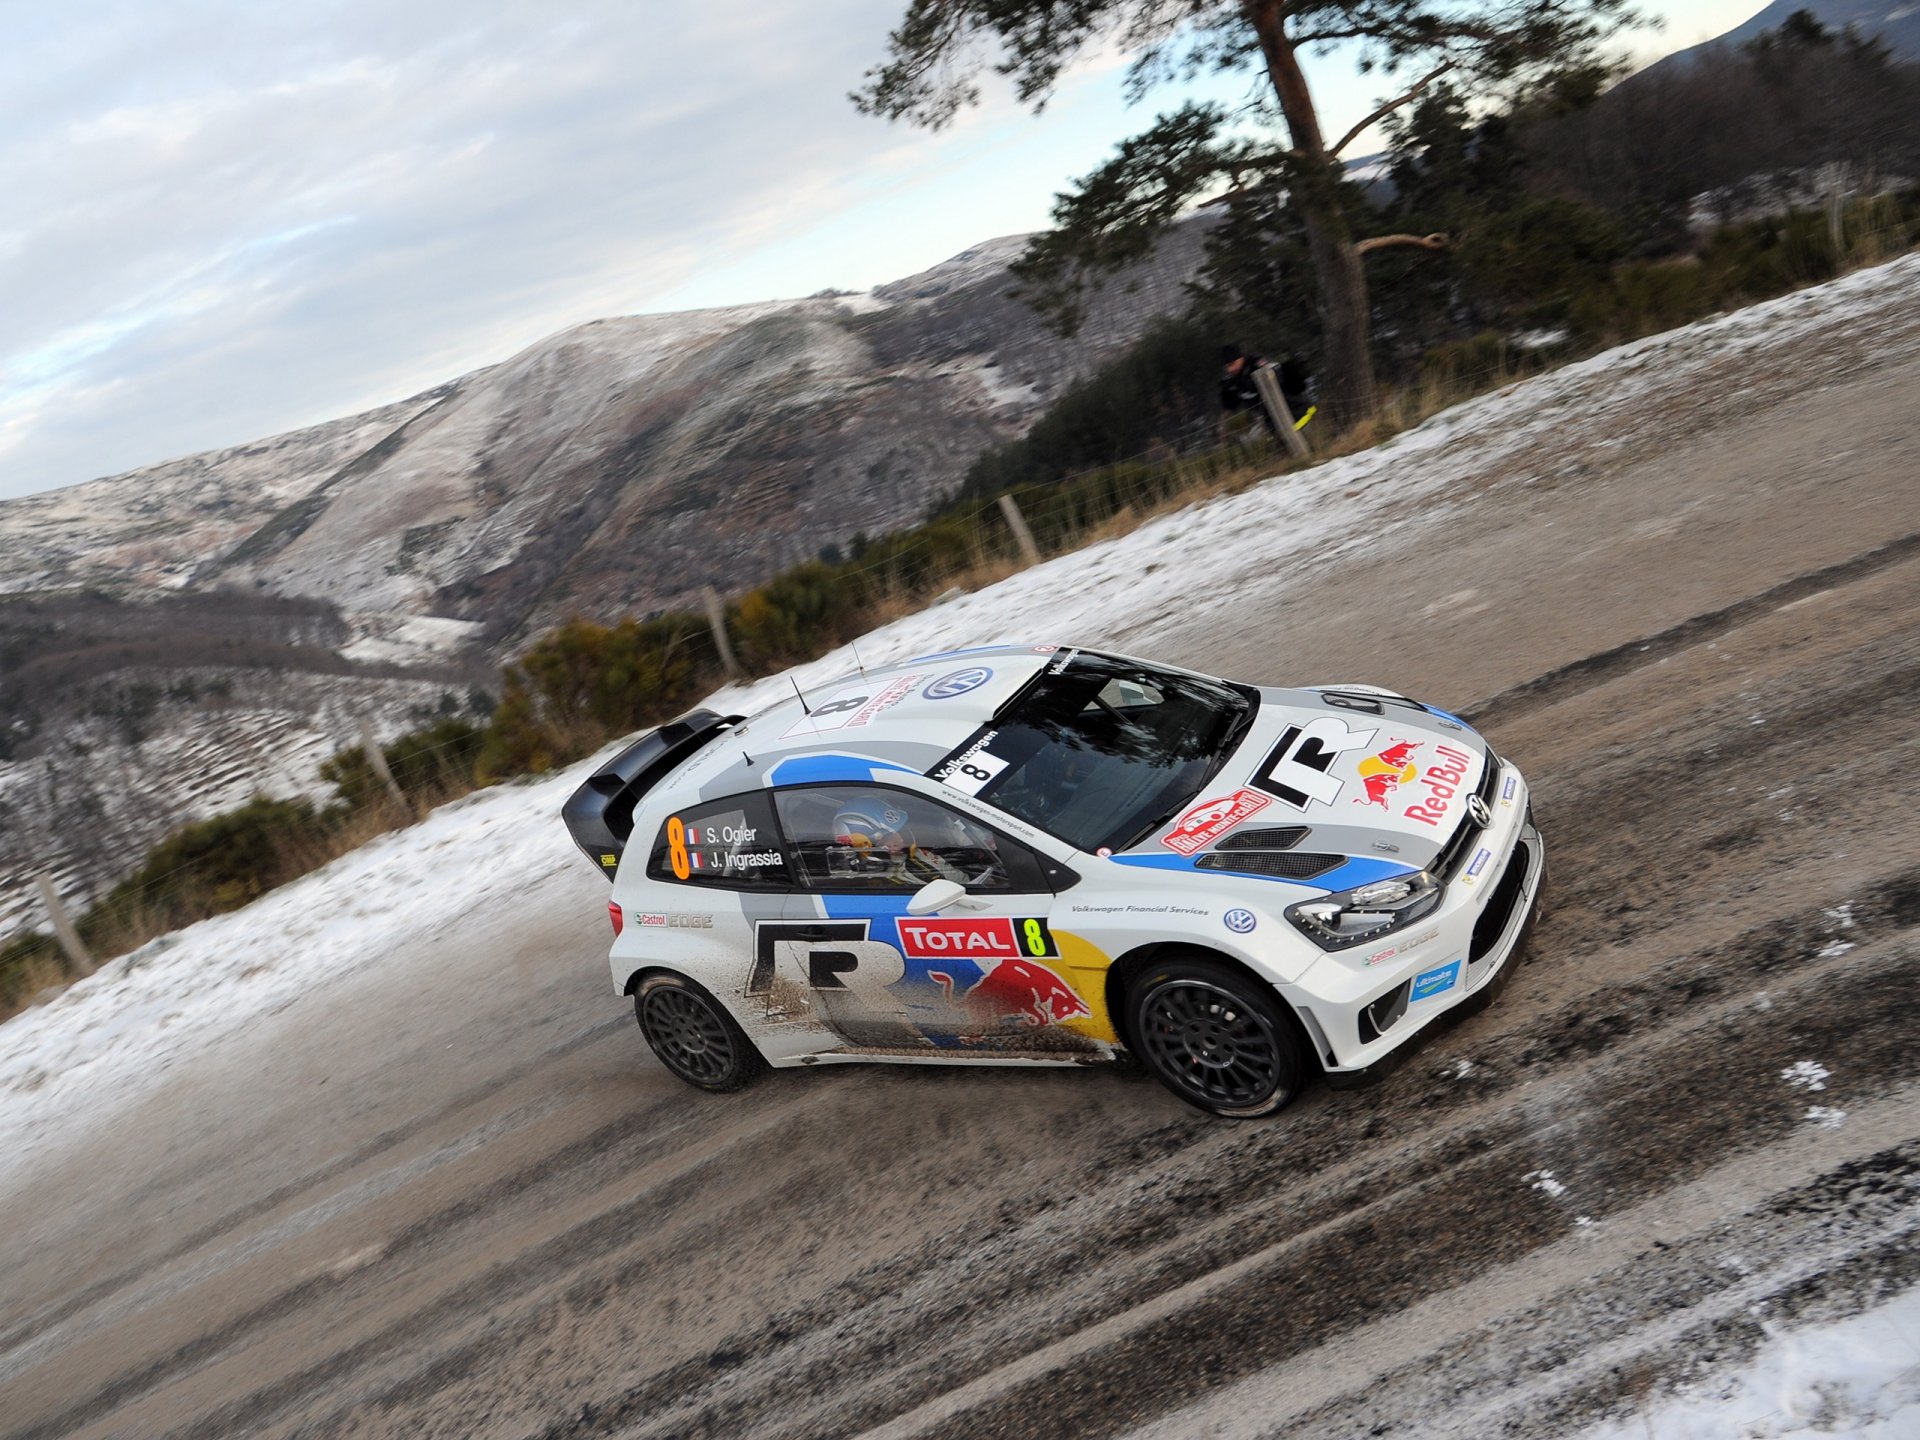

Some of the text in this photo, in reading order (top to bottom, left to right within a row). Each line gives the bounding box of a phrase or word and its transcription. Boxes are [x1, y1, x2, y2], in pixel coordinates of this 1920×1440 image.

[810, 695, 869, 718] 8
[934, 730, 999, 780] Volkswagen
[961, 764, 991, 781] 8
[706, 826, 757, 845] S. Ogier
[667, 816, 690, 880] 8
[711, 849, 783, 870] J. Ingrassia
[1072, 905, 1209, 916] Volkswagen Financial Services
[641, 914, 714, 928] Castrol EDGE
[904, 918, 1046, 956] TOTAL 8
[1371, 947, 1396, 964] Castrol
